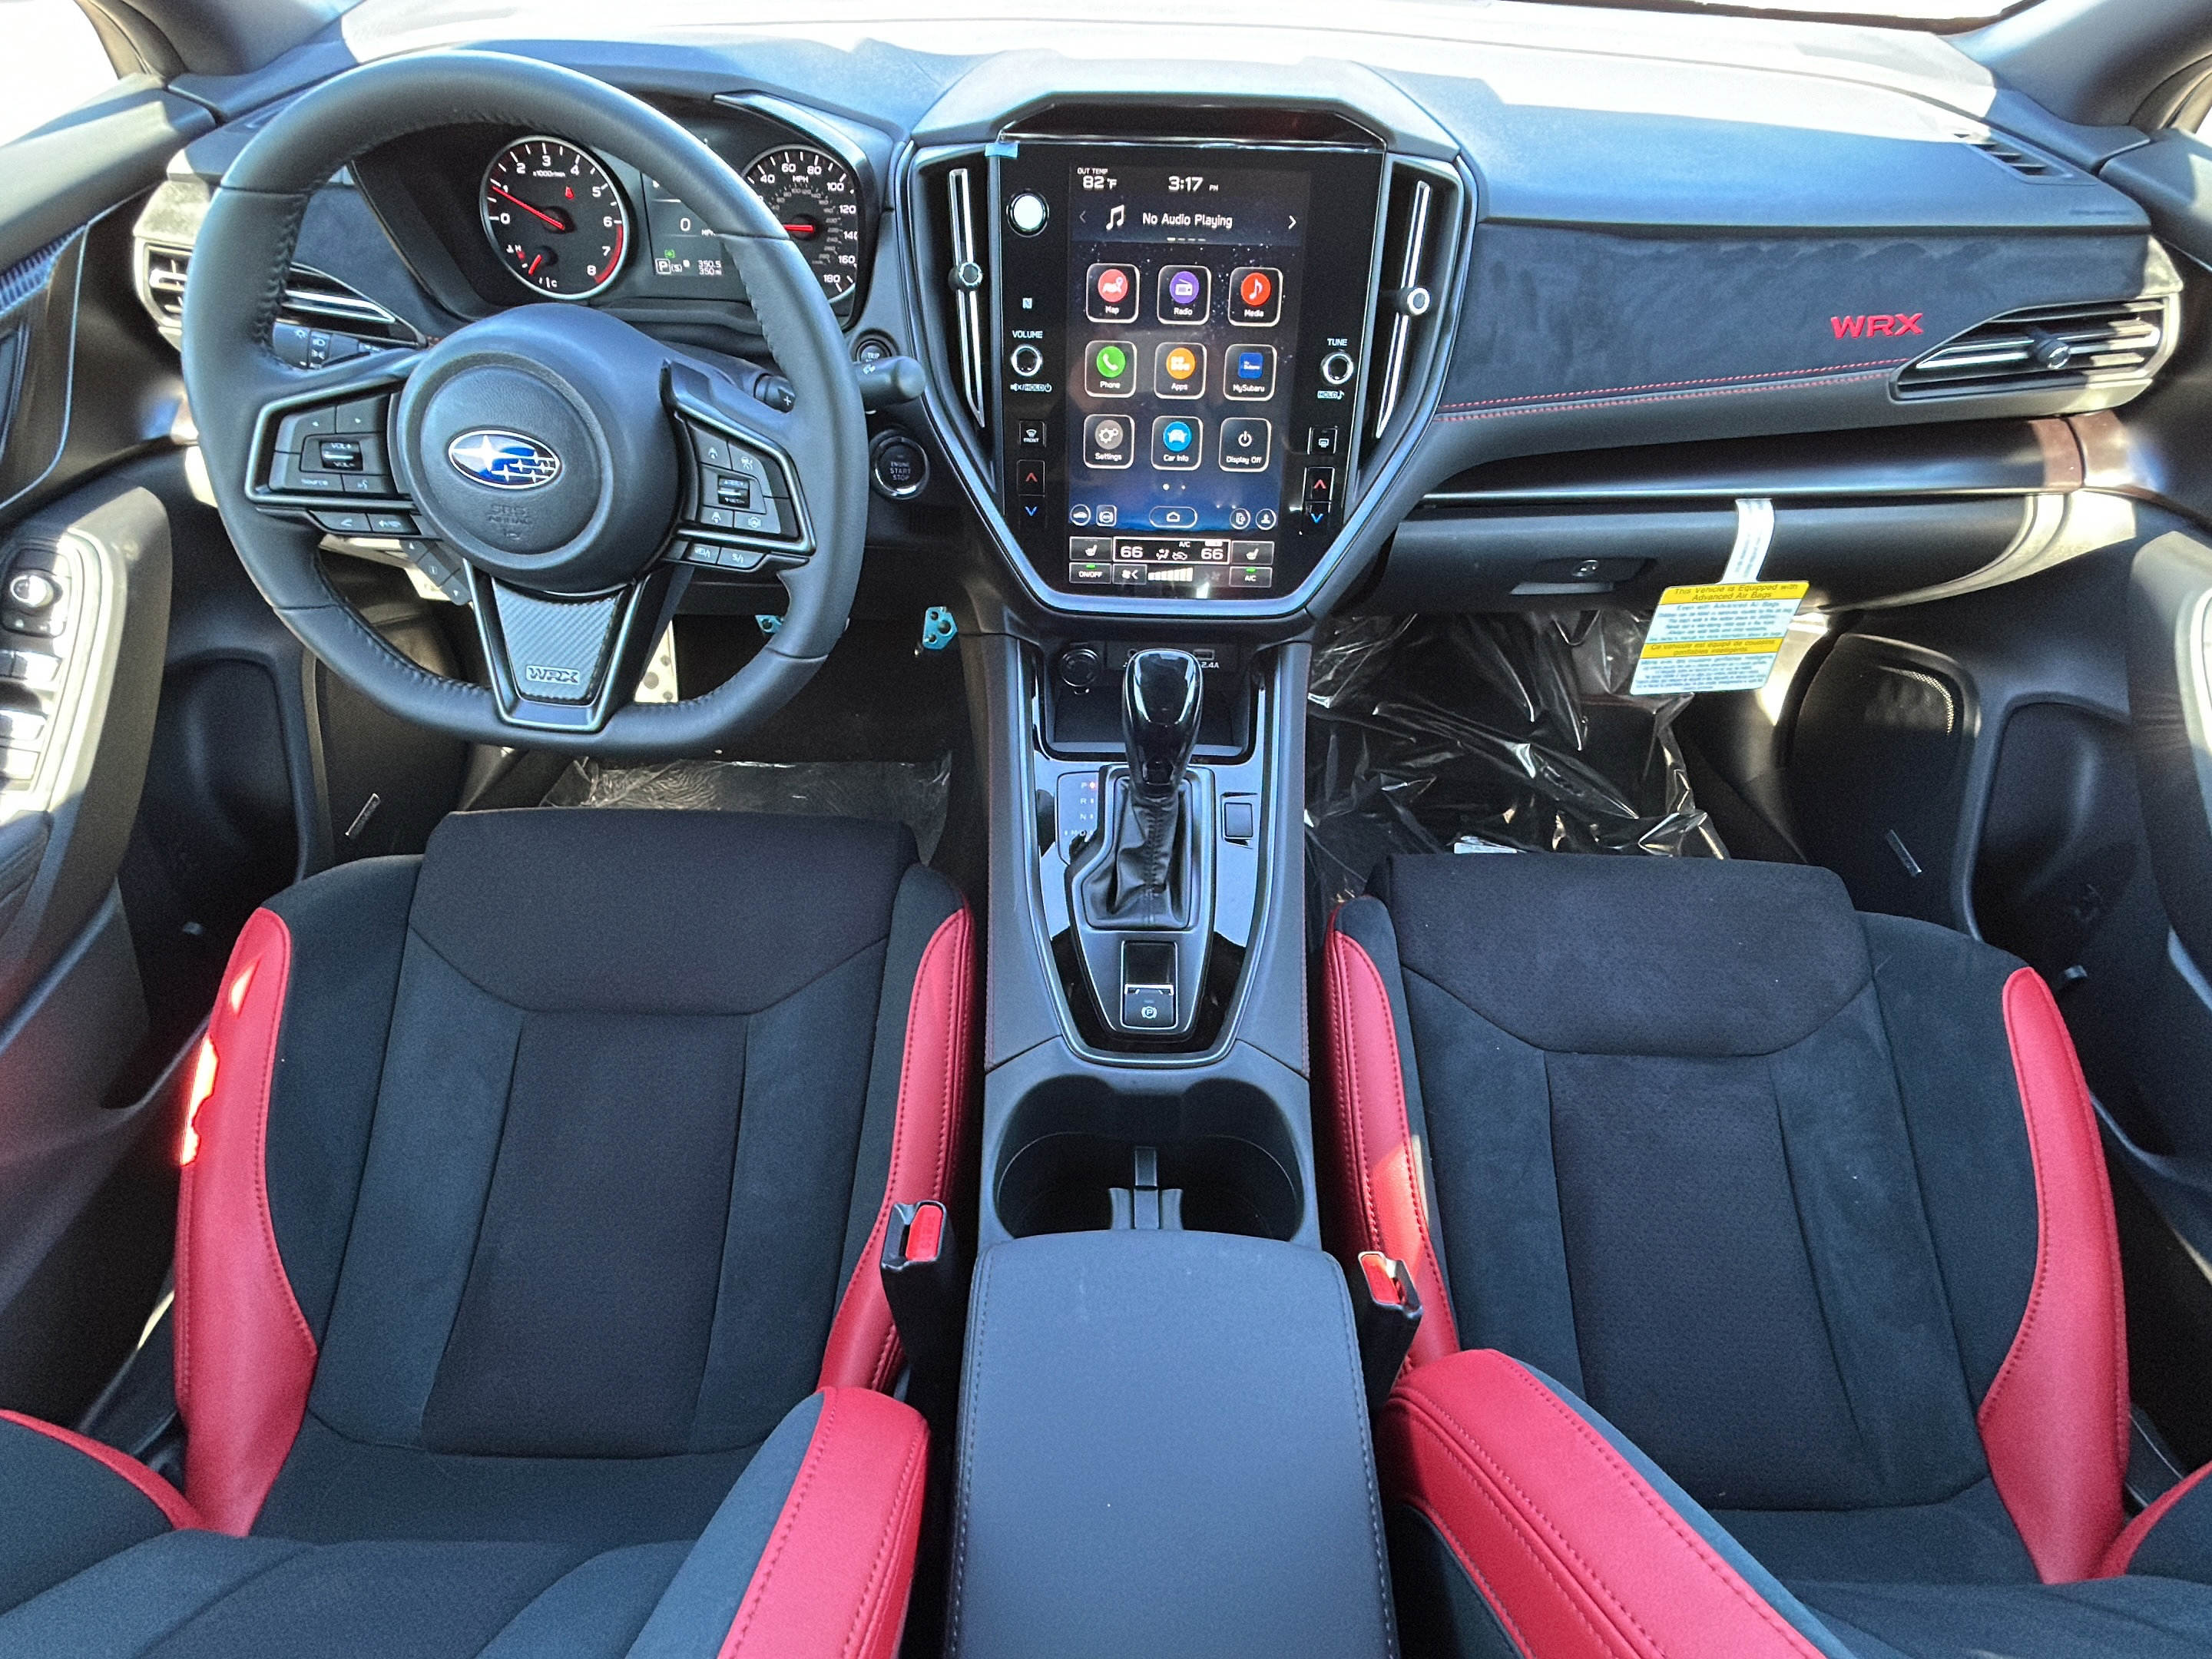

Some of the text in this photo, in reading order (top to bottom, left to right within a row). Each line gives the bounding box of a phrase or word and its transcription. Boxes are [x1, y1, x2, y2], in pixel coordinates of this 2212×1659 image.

[541, 155, 551, 167] 3
[516, 162, 526, 174] 2
[570, 164, 579, 175] 4
[781, 163, 796, 173] 60
[806, 166, 822, 175] 80
[760, 174, 776, 184] 40
[1083, 175, 1104, 190] 82
[1168, 175, 1204, 191] 3:17
[591, 186, 601, 197] 5
[826, 182, 845, 191] 100
[839, 204, 856, 214] 120
[501, 213, 510, 224] 0
[603, 217, 613, 227] 6
[1142, 213, 1233, 229] No Audio Playing
[680, 218, 691, 232] 0
[602, 246, 611, 257] 7
[838, 255, 856, 264] 160
[587, 264, 597, 276] 8
[659, 261, 668, 272] P
[697, 260, 722, 268] 350.5
[823, 274, 841, 283] 180
[1104, 306, 1119, 314] Map
[1174, 307, 1193, 316] Radio
[1244, 309, 1264, 317] Media
[1831, 313, 1923, 339] WRX
[1012, 330, 1043, 339] VOLUME
[1171, 382, 1187, 391] Apps
[1233, 384, 1265, 393] MySubaru
[1318, 390, 1338, 399] HOLD
[1094, 452, 1121, 461] Settings
[1226, 455, 1250, 465] Display
[1121, 545, 1144, 558] 66
[1200, 548, 1224, 560] 66
[1738, 584, 1778, 593] Equipped
[1692, 593, 1734, 601] Advanced
[1750, 591, 1772, 600] Bags
[528, 667, 578, 684] WRX
